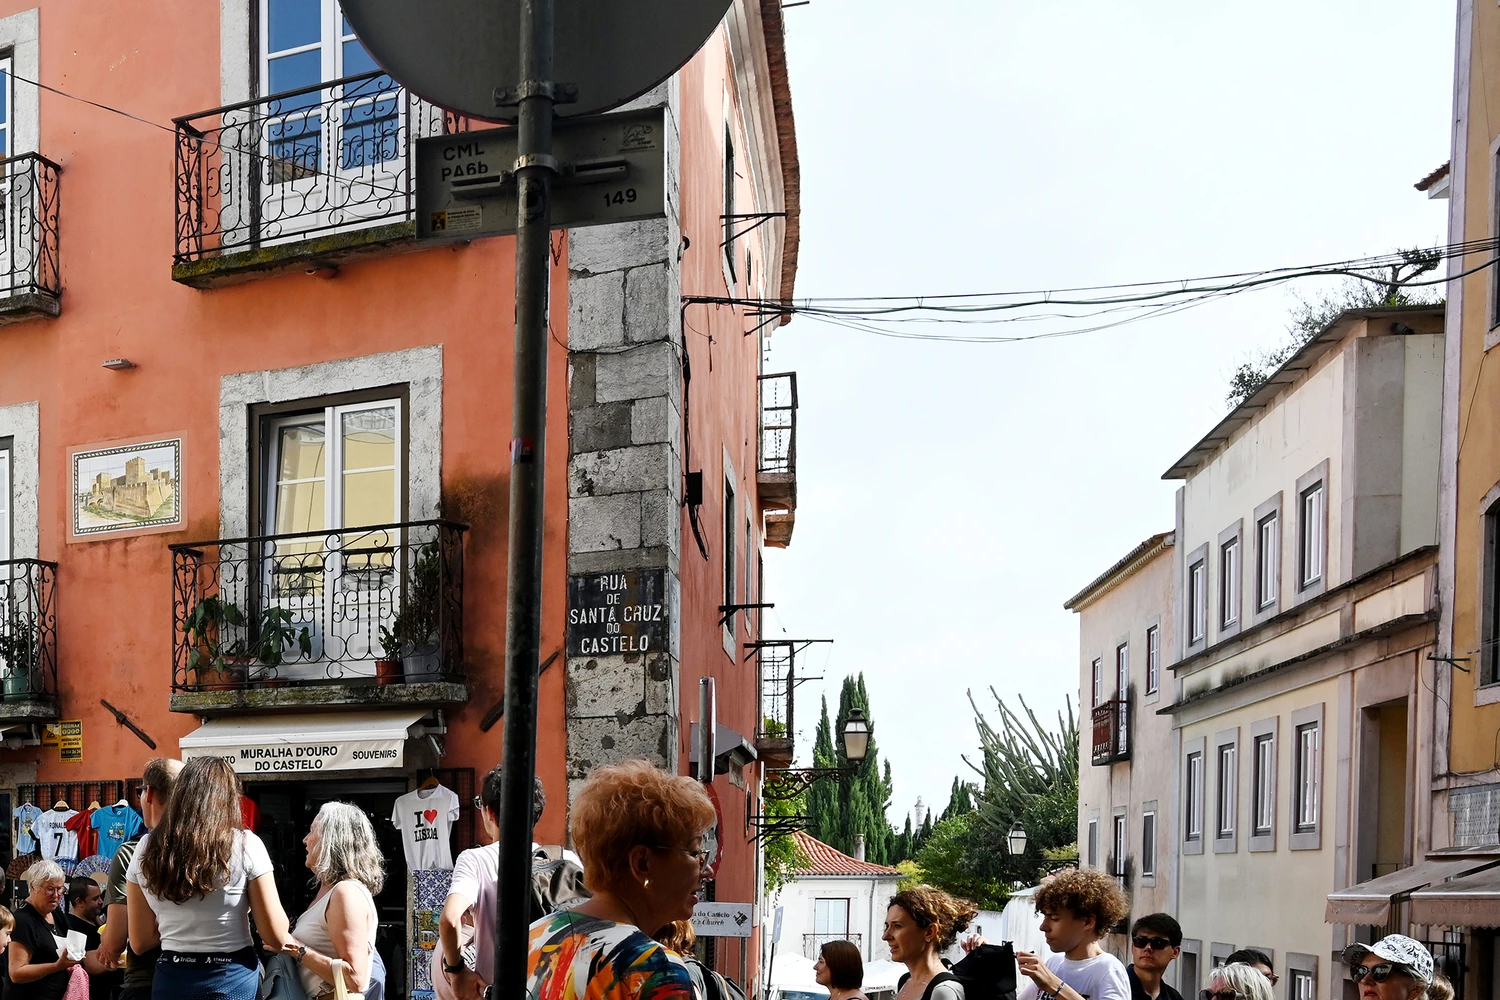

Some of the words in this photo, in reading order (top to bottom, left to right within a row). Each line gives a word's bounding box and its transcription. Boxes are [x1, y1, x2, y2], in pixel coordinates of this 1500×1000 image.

[443, 142, 485, 161] CML
[604, 187, 637, 207] 149
[600, 574, 627, 591] RUA
[606, 593, 620, 605] DE
[570, 606, 617, 625] SANTA
[623, 605, 661, 622] CRUZ
[606, 622, 620, 634] DO
[581, 635, 648, 654] CASTELO
[240, 749, 293, 760] MURALHA
[296, 745, 338, 757] D'OURO
[352, 749, 397, 760] SOUVENIRS
[255, 761, 272, 771] DO
[273, 759, 323, 770] CASTELO
[414, 810, 424, 828] I
[53, 832, 63, 857] 7
